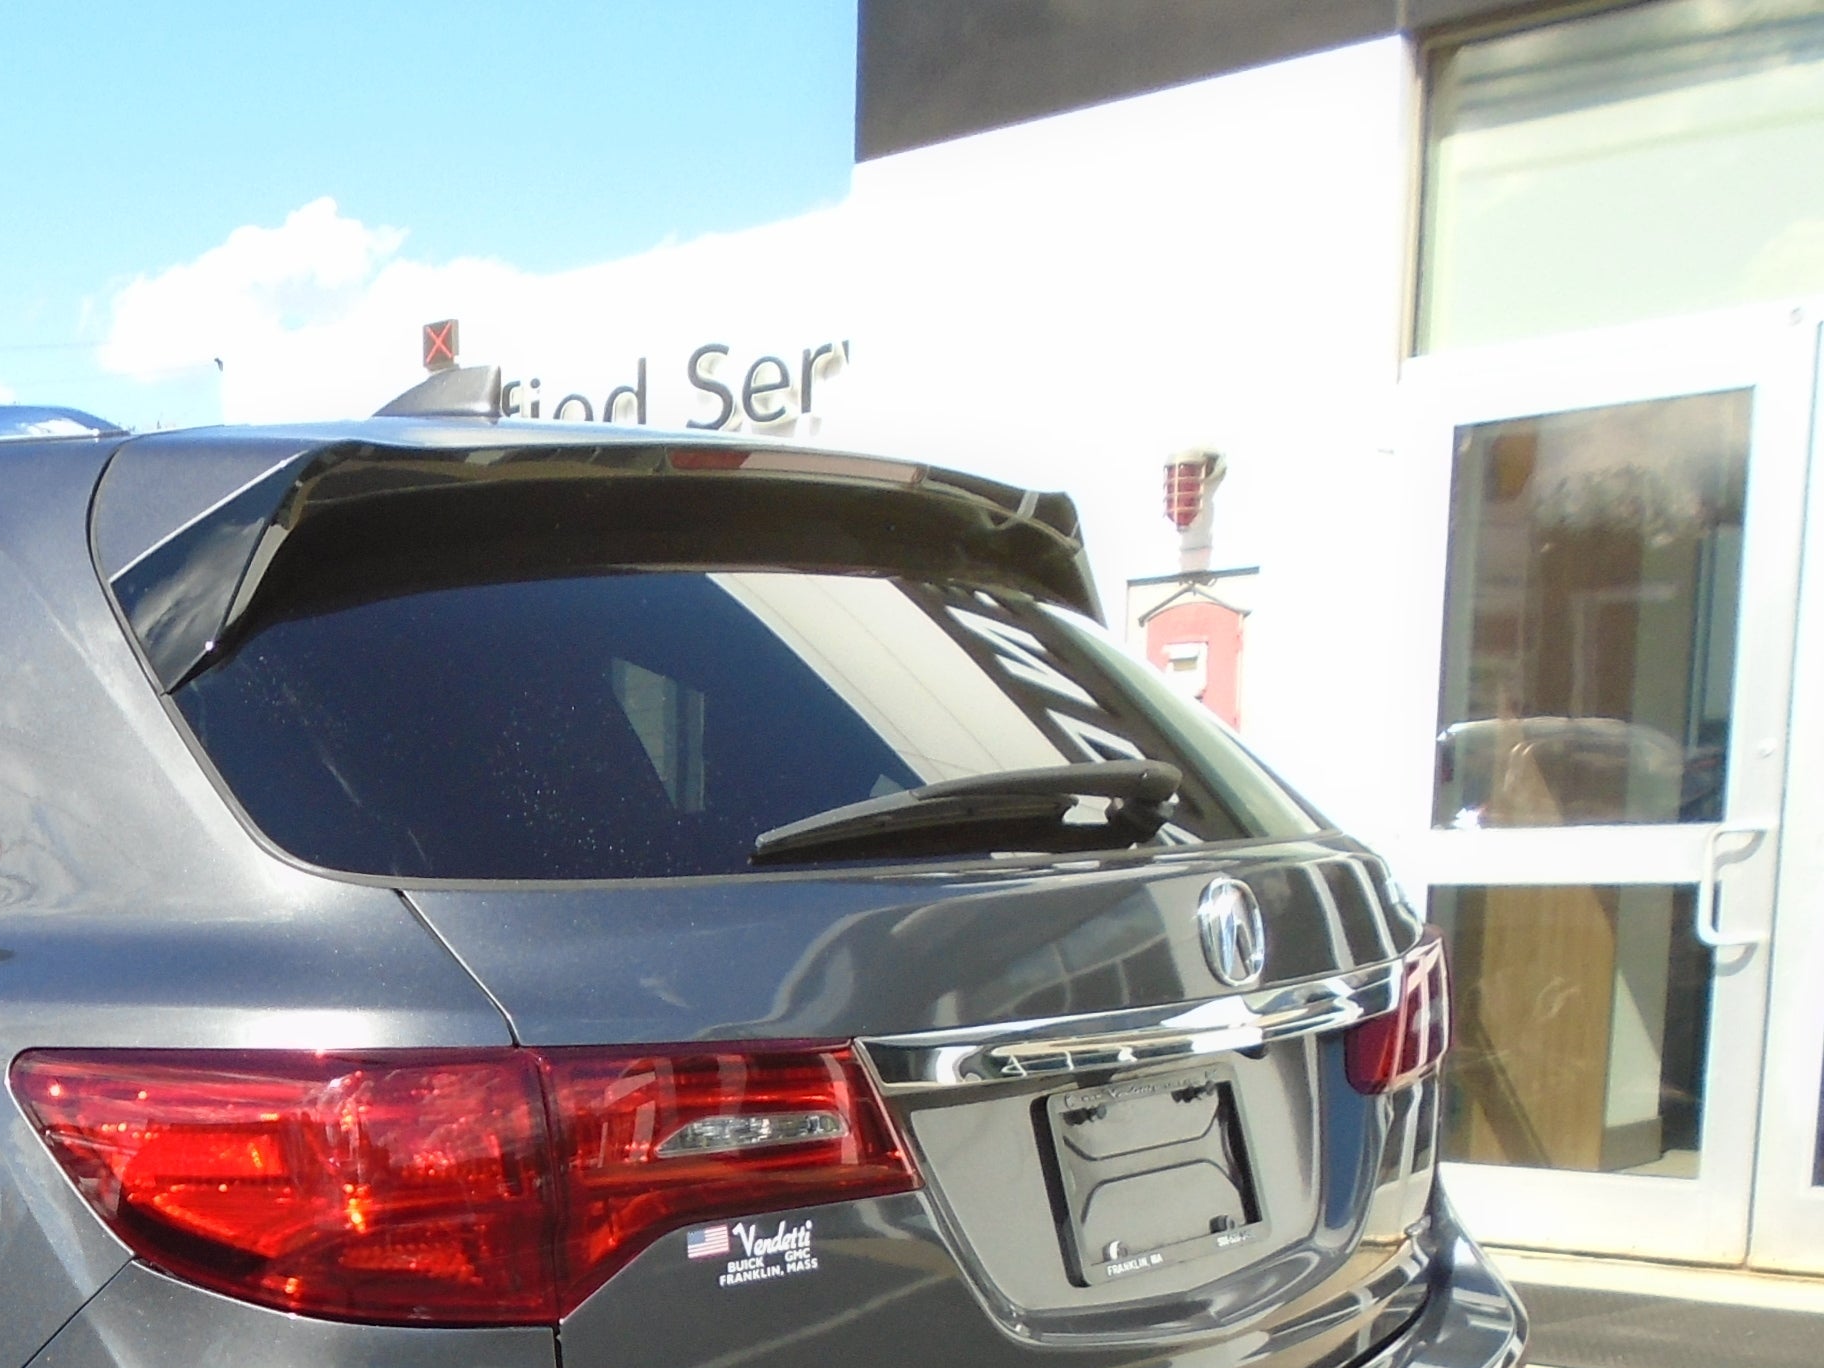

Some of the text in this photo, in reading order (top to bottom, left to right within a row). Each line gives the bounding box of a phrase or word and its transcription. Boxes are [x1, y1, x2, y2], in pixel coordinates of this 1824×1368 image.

[686, 340, 849, 431] Ser
[732, 1220, 813, 1257] Vendetti
[719, 1257, 819, 1287] FRANKLIN, MASS
[727, 1248, 811, 1273] BUICK GMC
